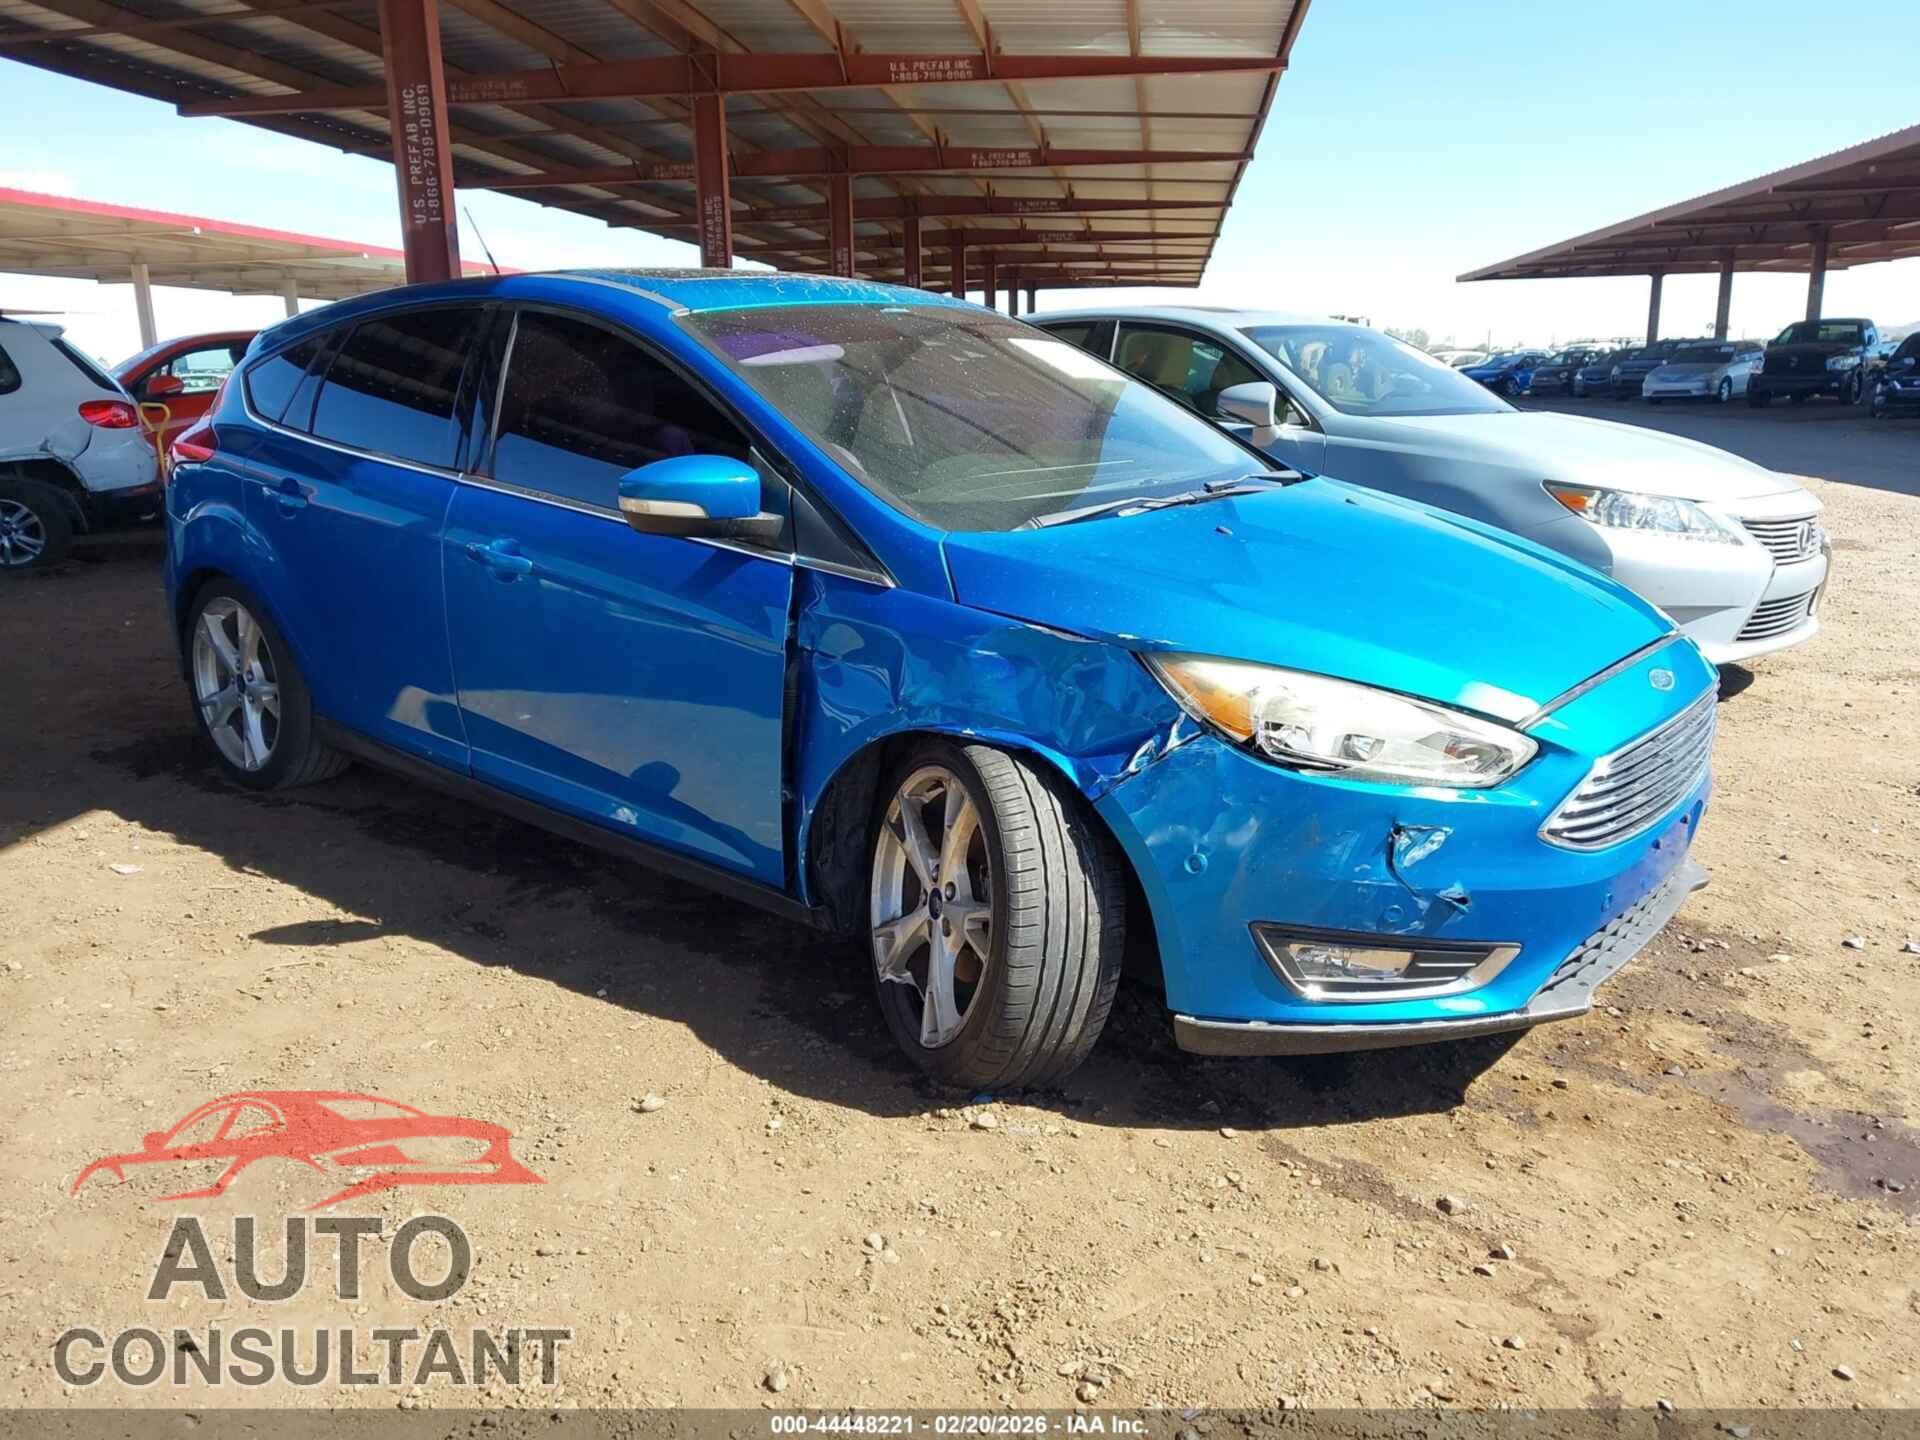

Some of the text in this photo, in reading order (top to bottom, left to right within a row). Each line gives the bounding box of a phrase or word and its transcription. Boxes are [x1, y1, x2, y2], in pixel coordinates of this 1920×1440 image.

[912, 60, 950, 71] PREFAB
[954, 59, 974, 69] INC.
[402, 83, 427, 224] U.S. PREFAB INC.
[416, 83, 441, 222] 1-866-799-0969
